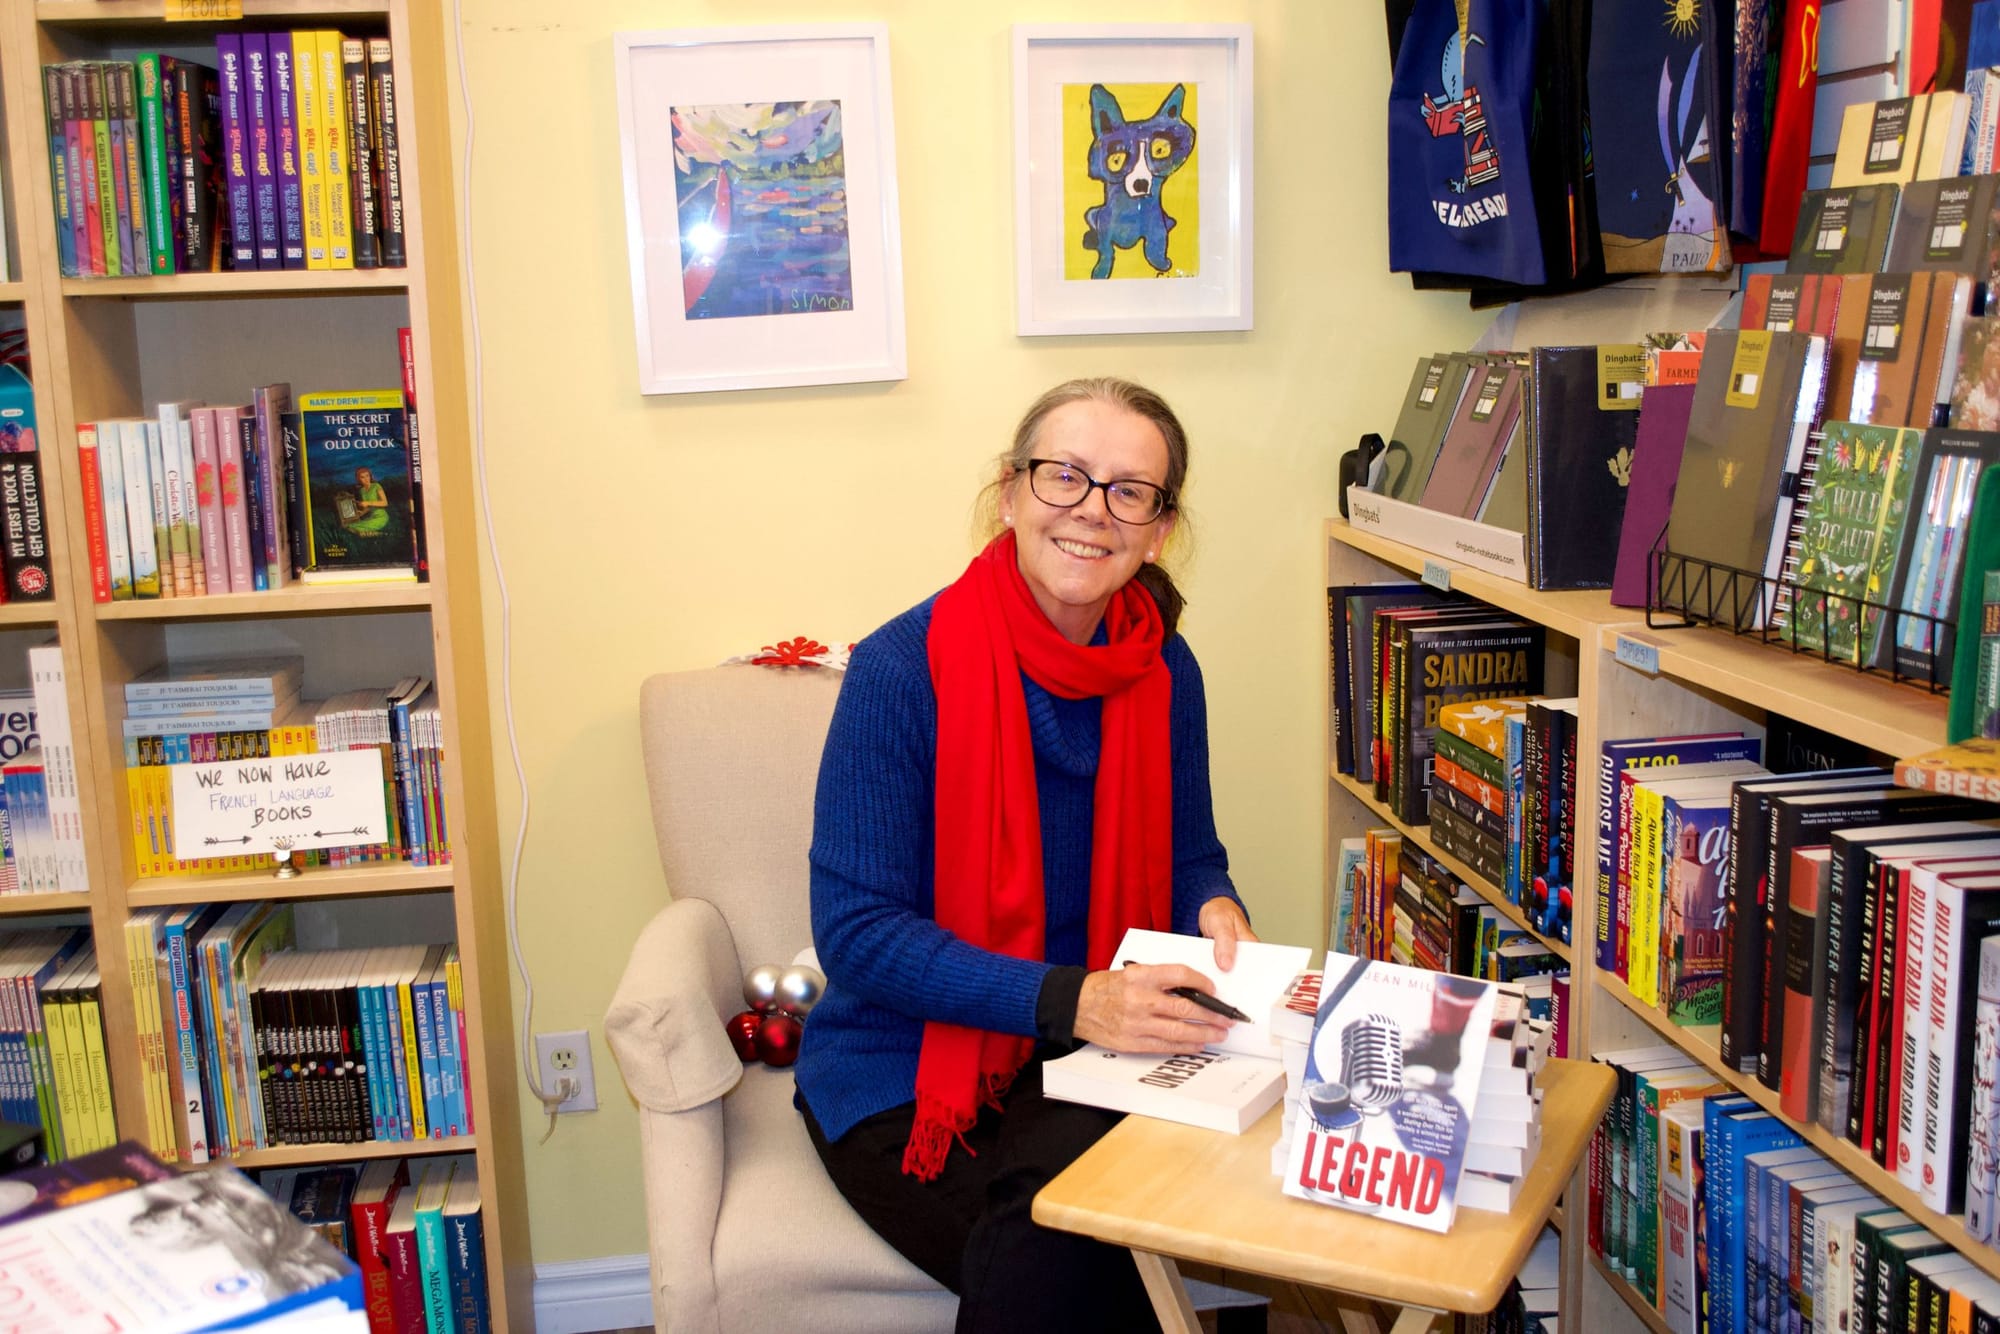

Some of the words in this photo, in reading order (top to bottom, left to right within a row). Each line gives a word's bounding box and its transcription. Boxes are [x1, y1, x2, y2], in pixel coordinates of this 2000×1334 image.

[383, 74, 394, 124] KILLERS
[1877, 107, 1904, 121] Dingbats
[186, 158, 194, 176] THE
[389, 149, 400, 196] FLOWER
[187, 181, 196, 213] CRASH
[1824, 198, 1849, 210] Dingbats
[1940, 189, 1969, 203] Dingbats
[392, 200, 402, 232] MOON
[1772, 288, 1796, 301] Dingbats
[1873, 287, 1902, 305] Dingbats
[310, 398, 335, 406] NANCY
[337, 397, 359, 406] DREW
[324, 415, 347, 425] THE
[350, 413, 391, 424] SECRET
[224, 433, 234, 458] Women
[324, 439, 350, 450] OLD
[354, 438, 394, 449] CLOCK
[338, 427, 354, 437] OF
[358, 426, 380, 436] THE
[2, 464, 15, 473] &
[4, 475, 19, 503] ROCK
[21, 464, 40, 534] COLLECTION
[1832, 486, 1881, 525] WILD
[8, 506, 22, 538] FIRST
[1353, 503, 1380, 524] Dingbats
[13, 542, 26, 557] MY
[31, 537, 44, 557] GEM
[1816, 520, 1875, 558] BEAUT
[1440, 640, 1455, 648] YORK
[1456, 639, 1473, 647] TIMES
[1474, 638, 1509, 646] BESTSELLING
[1511, 637, 1532, 645] AUTHOR
[1424, 650, 1528, 688] SANDRA
[238, 765, 273, 785] NOW
[1535, 741, 1545, 785] JANE
[1560, 749, 1569, 795] JANE
[1566, 757, 1576, 823] KILLING
[1598, 753, 1613, 832] CHOOSE
[0, 809, 12, 850] SHARKS
[251, 805, 312, 828] BOOKS
[1527, 813, 1535, 840] other
[1534, 789, 1544, 844] CASEY
[1559, 798, 1569, 853] CASEY
[1731, 793, 1740, 831] CHRIS
[1769, 807, 1778, 845] CHRIS
[1525, 842, 1534, 892] passenger
[1565, 827, 1575, 874] KIND
[1597, 837, 1611, 867] ME
[1728, 835, 1738, 896] HADFIELD
[1597, 873, 1610, 894] TESS
[1766, 849, 1776, 913] HADFIELD
[1830, 850, 1846, 896] JANE
[1883, 892, 1895, 902] A
[1597, 895, 1609, 942] GERRITSEN
[1826, 901, 1843, 972] HARPER
[1881, 905, 1894, 943] LINE
[1907, 884, 1926, 953] BULLET
[1932, 899, 1951, 971] BULLET
[168, 936, 185, 987] Programme
[1881, 947, 1892, 964] TO
[1364, 971, 1401, 987] JEAN
[1829, 977, 1837, 996] THE
[1880, 966, 1892, 998] KILL
[1904, 954, 1922, 1013] TRAIN
[176, 990, 191, 1031] canadien
[416, 991, 429, 1024] Encore
[434, 989, 446, 1021] Encore
[1686, 991, 1720, 1011] Mario
[1928, 972, 1948, 1031] TRAIN
[421, 1027, 430, 1039] un
[422, 1040, 436, 1059] but!
[438, 1025, 446, 1037] un
[440, 1038, 453, 1057] but!
[1823, 997, 1837, 1072] SURVIVORS
[181, 1033, 194, 1071] complet
[1900, 1031, 1918, 1087] KOTARO
[55, 1052, 72, 1114] Hummingbirds
[73, 1052, 89, 1114] Hummingbirds
[91, 1050, 107, 1113] Hummingbirds
[1924, 1050, 1942, 1106] KOTARO
[189, 1100, 200, 1114] 2
[1310, 1118, 1330, 1134] The
[1898, 1089, 1914, 1133] ISAKA
[1922, 1107, 1939, 1155] ISAKA
[1299, 1131, 1445, 1215] LEGEND
[1725, 1132, 1733, 1197] WILLIAM
[1747, 1164, 1758, 1217] BOUNDARY
[1770, 1179, 1781, 1231] BOUNDARY
[1663, 1190, 1689, 1232] STEPHEN
[1725, 1200, 1733, 1240] KENT
[1790, 1201, 1800, 1236] SULFUR
[1803, 1208, 1814, 1243] IRON
[1670, 1223, 1685, 1259] KING
[1747, 1221, 1757, 1259] WATERS
[1769, 1235, 1779, 1273] WATERS
[1790, 1238, 1799, 1276] SPRINGS
[1815, 1218, 1826, 1280] PURGATORY
[1803, 1251, 1813, 1289] LAKE
[1854, 1239, 1866, 1301] DEAN
[1815, 1283, 1825, 1315] RIDGE
[1877, 1259, 1889, 1321] DEAN
[1907, 1275, 1920, 1333] NEVER
